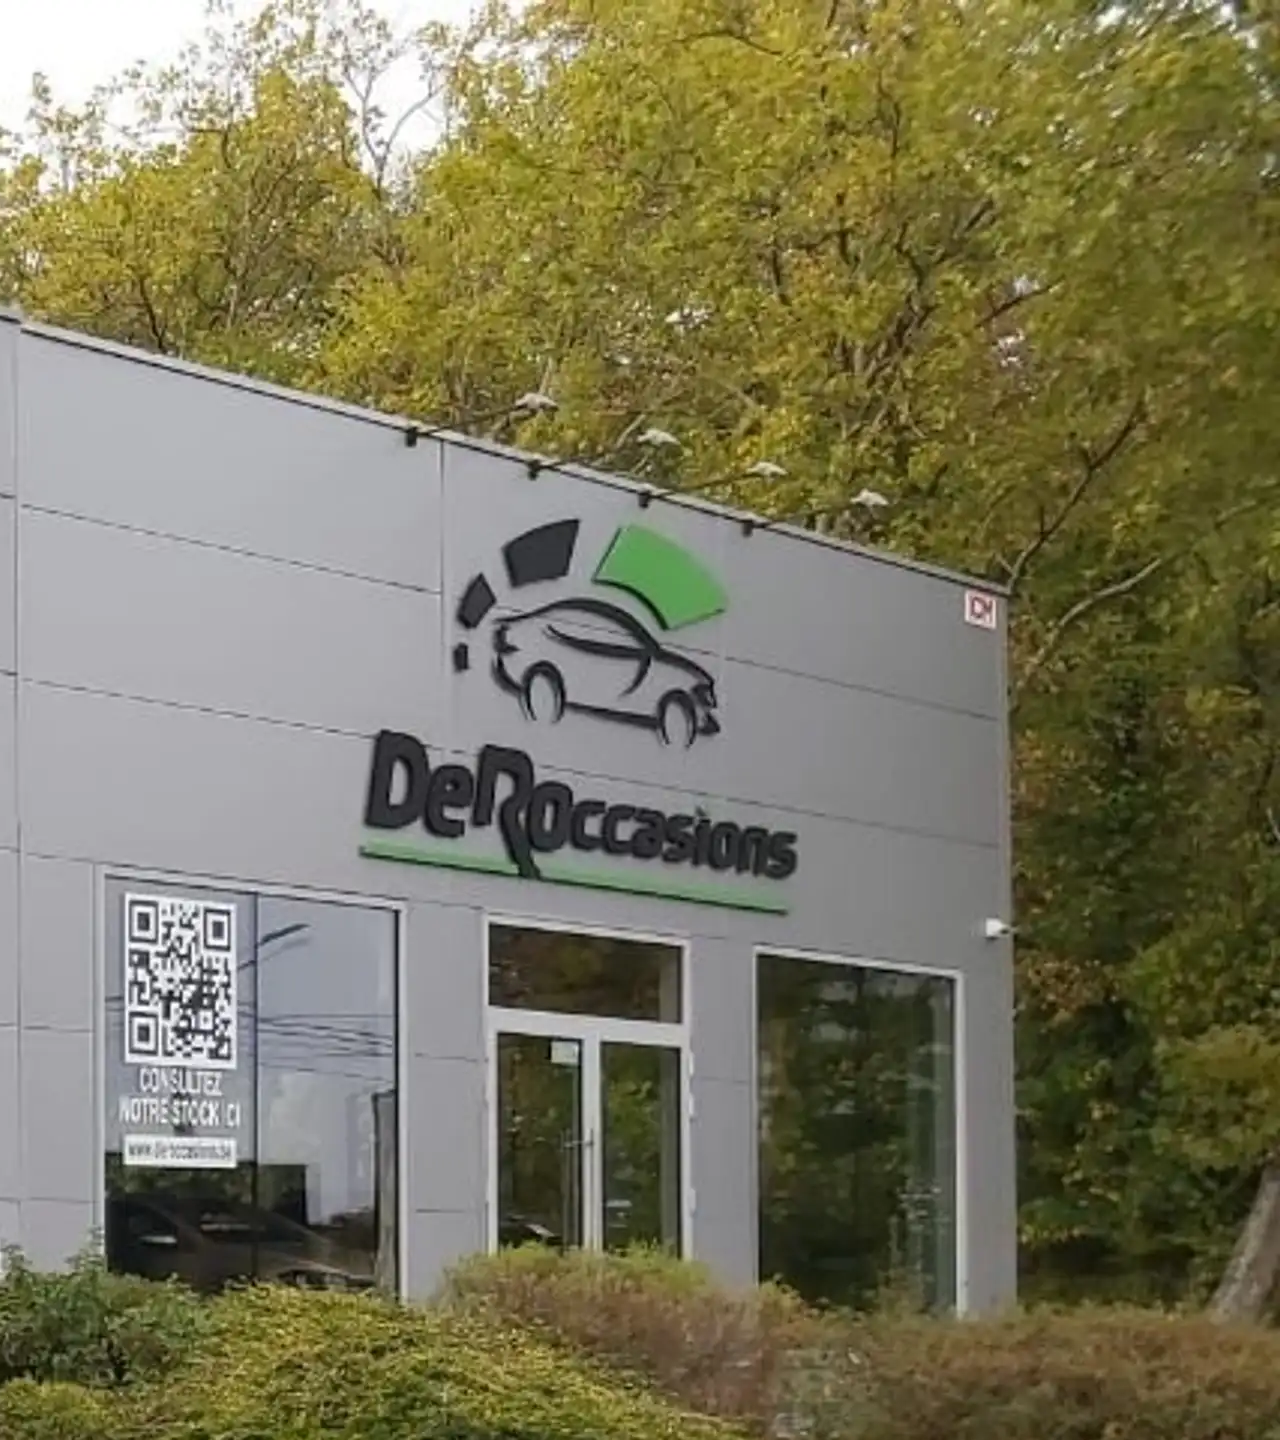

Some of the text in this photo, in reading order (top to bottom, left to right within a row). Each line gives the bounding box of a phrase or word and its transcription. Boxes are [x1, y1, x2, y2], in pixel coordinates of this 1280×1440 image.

[140, 1066, 223, 1097] CONSULTEZ
[119, 1096, 169, 1124] NOTRE
[171, 1099, 220, 1127] STOCK
